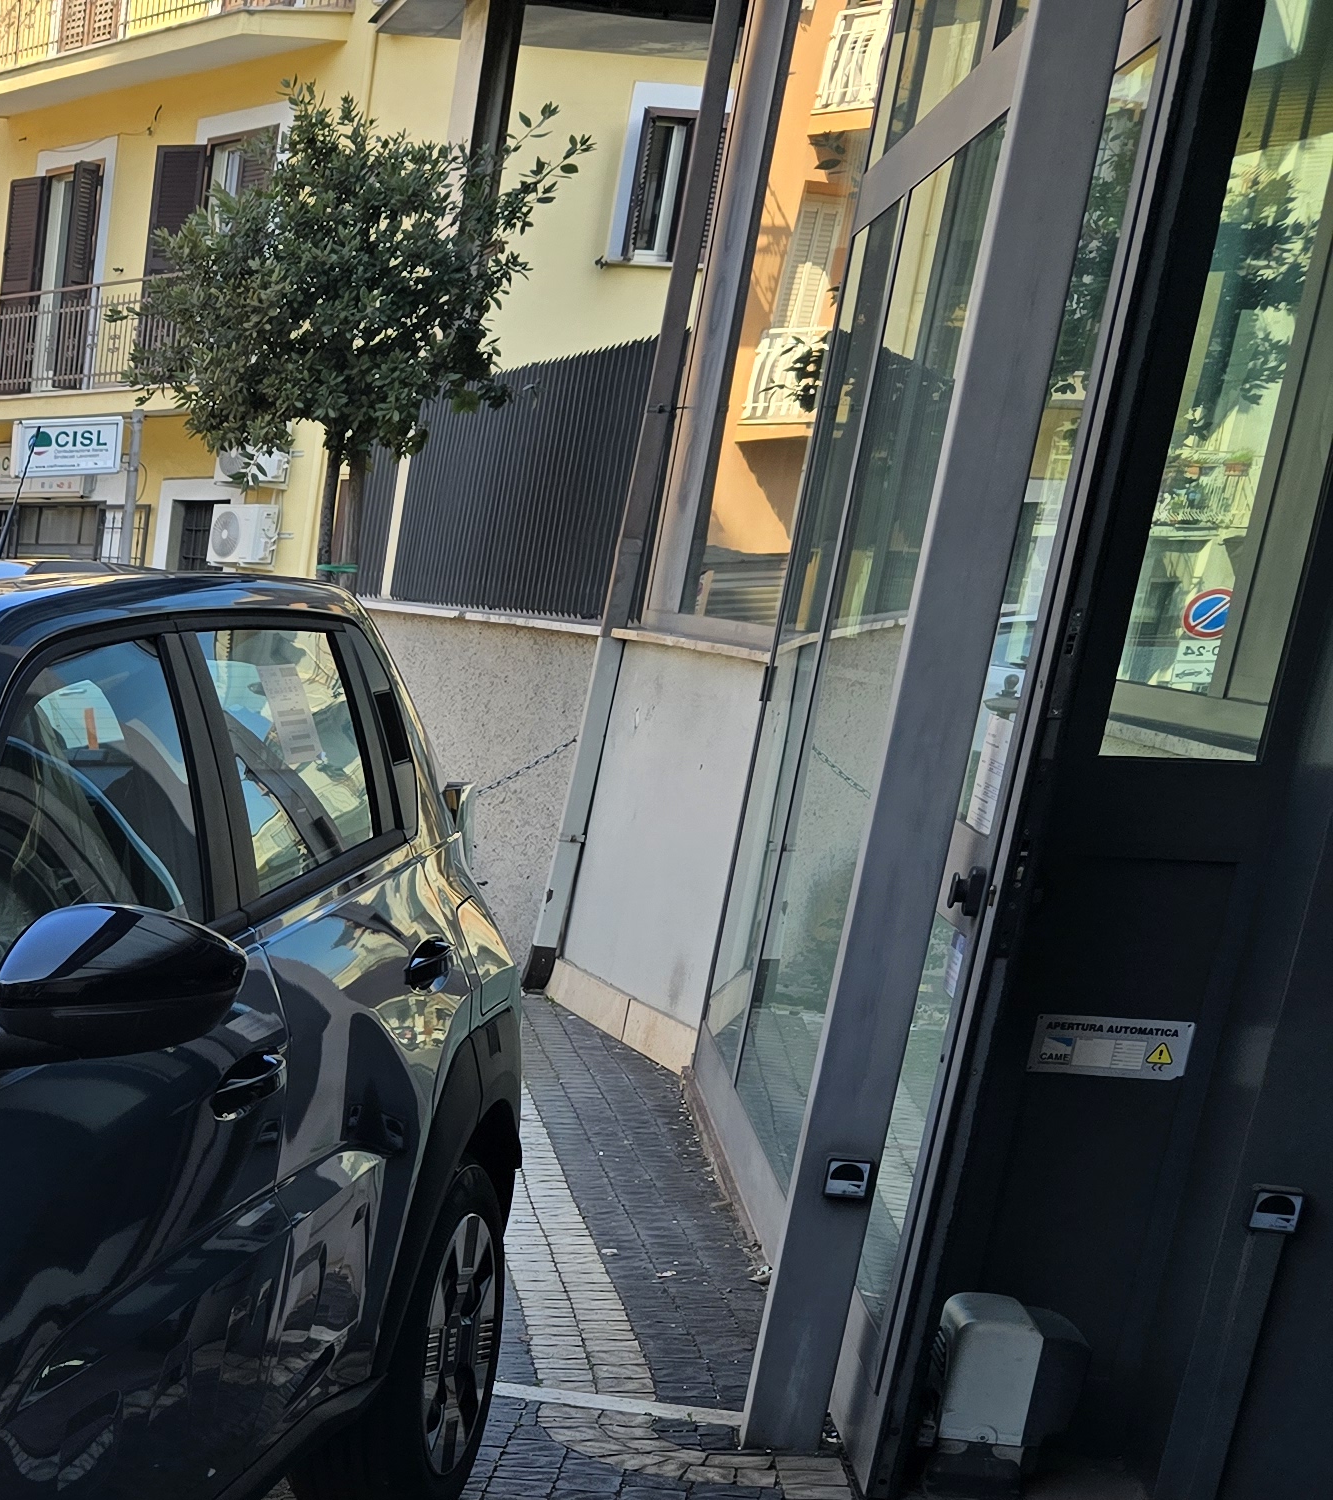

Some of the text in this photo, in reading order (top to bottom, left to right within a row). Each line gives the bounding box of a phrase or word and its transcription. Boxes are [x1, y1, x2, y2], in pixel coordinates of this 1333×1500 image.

[55, 430, 107, 447] CISL
[1045, 1021, 1179, 1038] APERTURA AUTOMATICA
[1039, 1052, 1070, 1062] CAME
